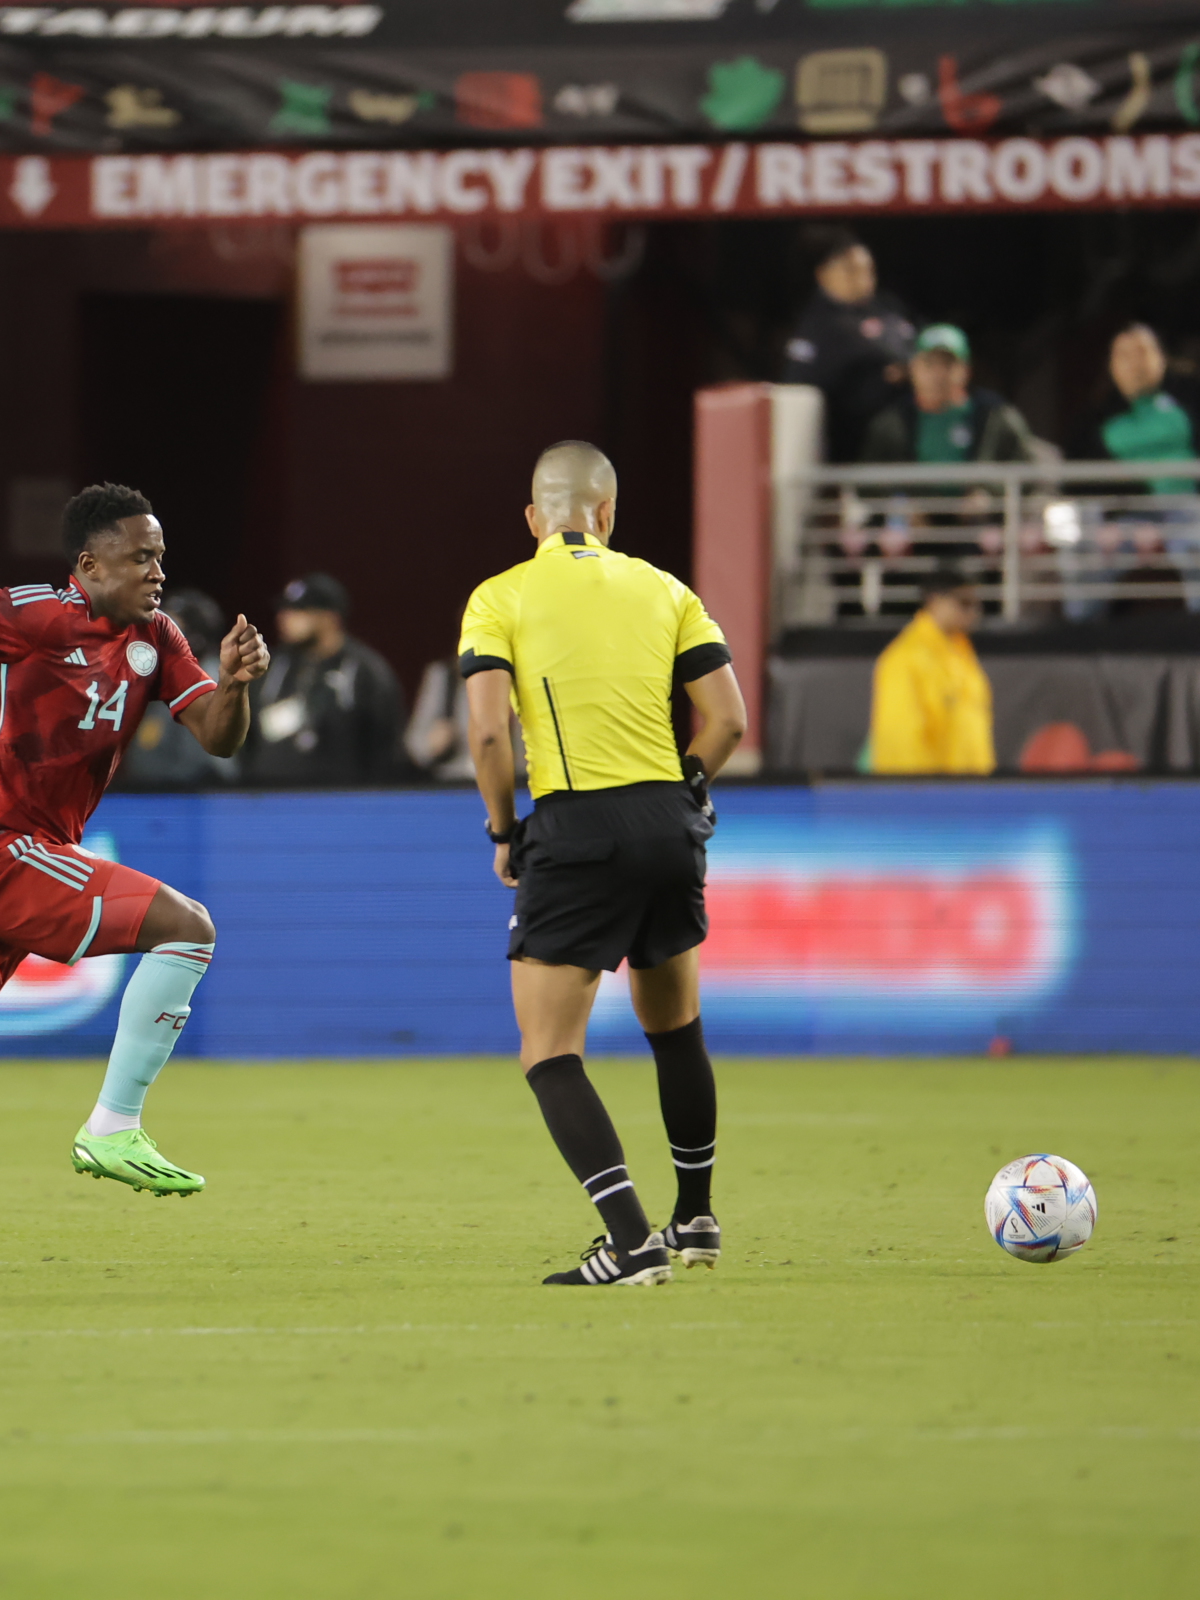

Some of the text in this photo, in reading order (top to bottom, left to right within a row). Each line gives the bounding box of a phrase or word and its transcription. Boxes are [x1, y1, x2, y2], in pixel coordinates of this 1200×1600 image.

[90, 149, 535, 218] EMERGENCY
[541, 146, 712, 211] EXIT
[756, 136, 1200, 207] RESTROOMS
[78, 680, 128, 731] 14
